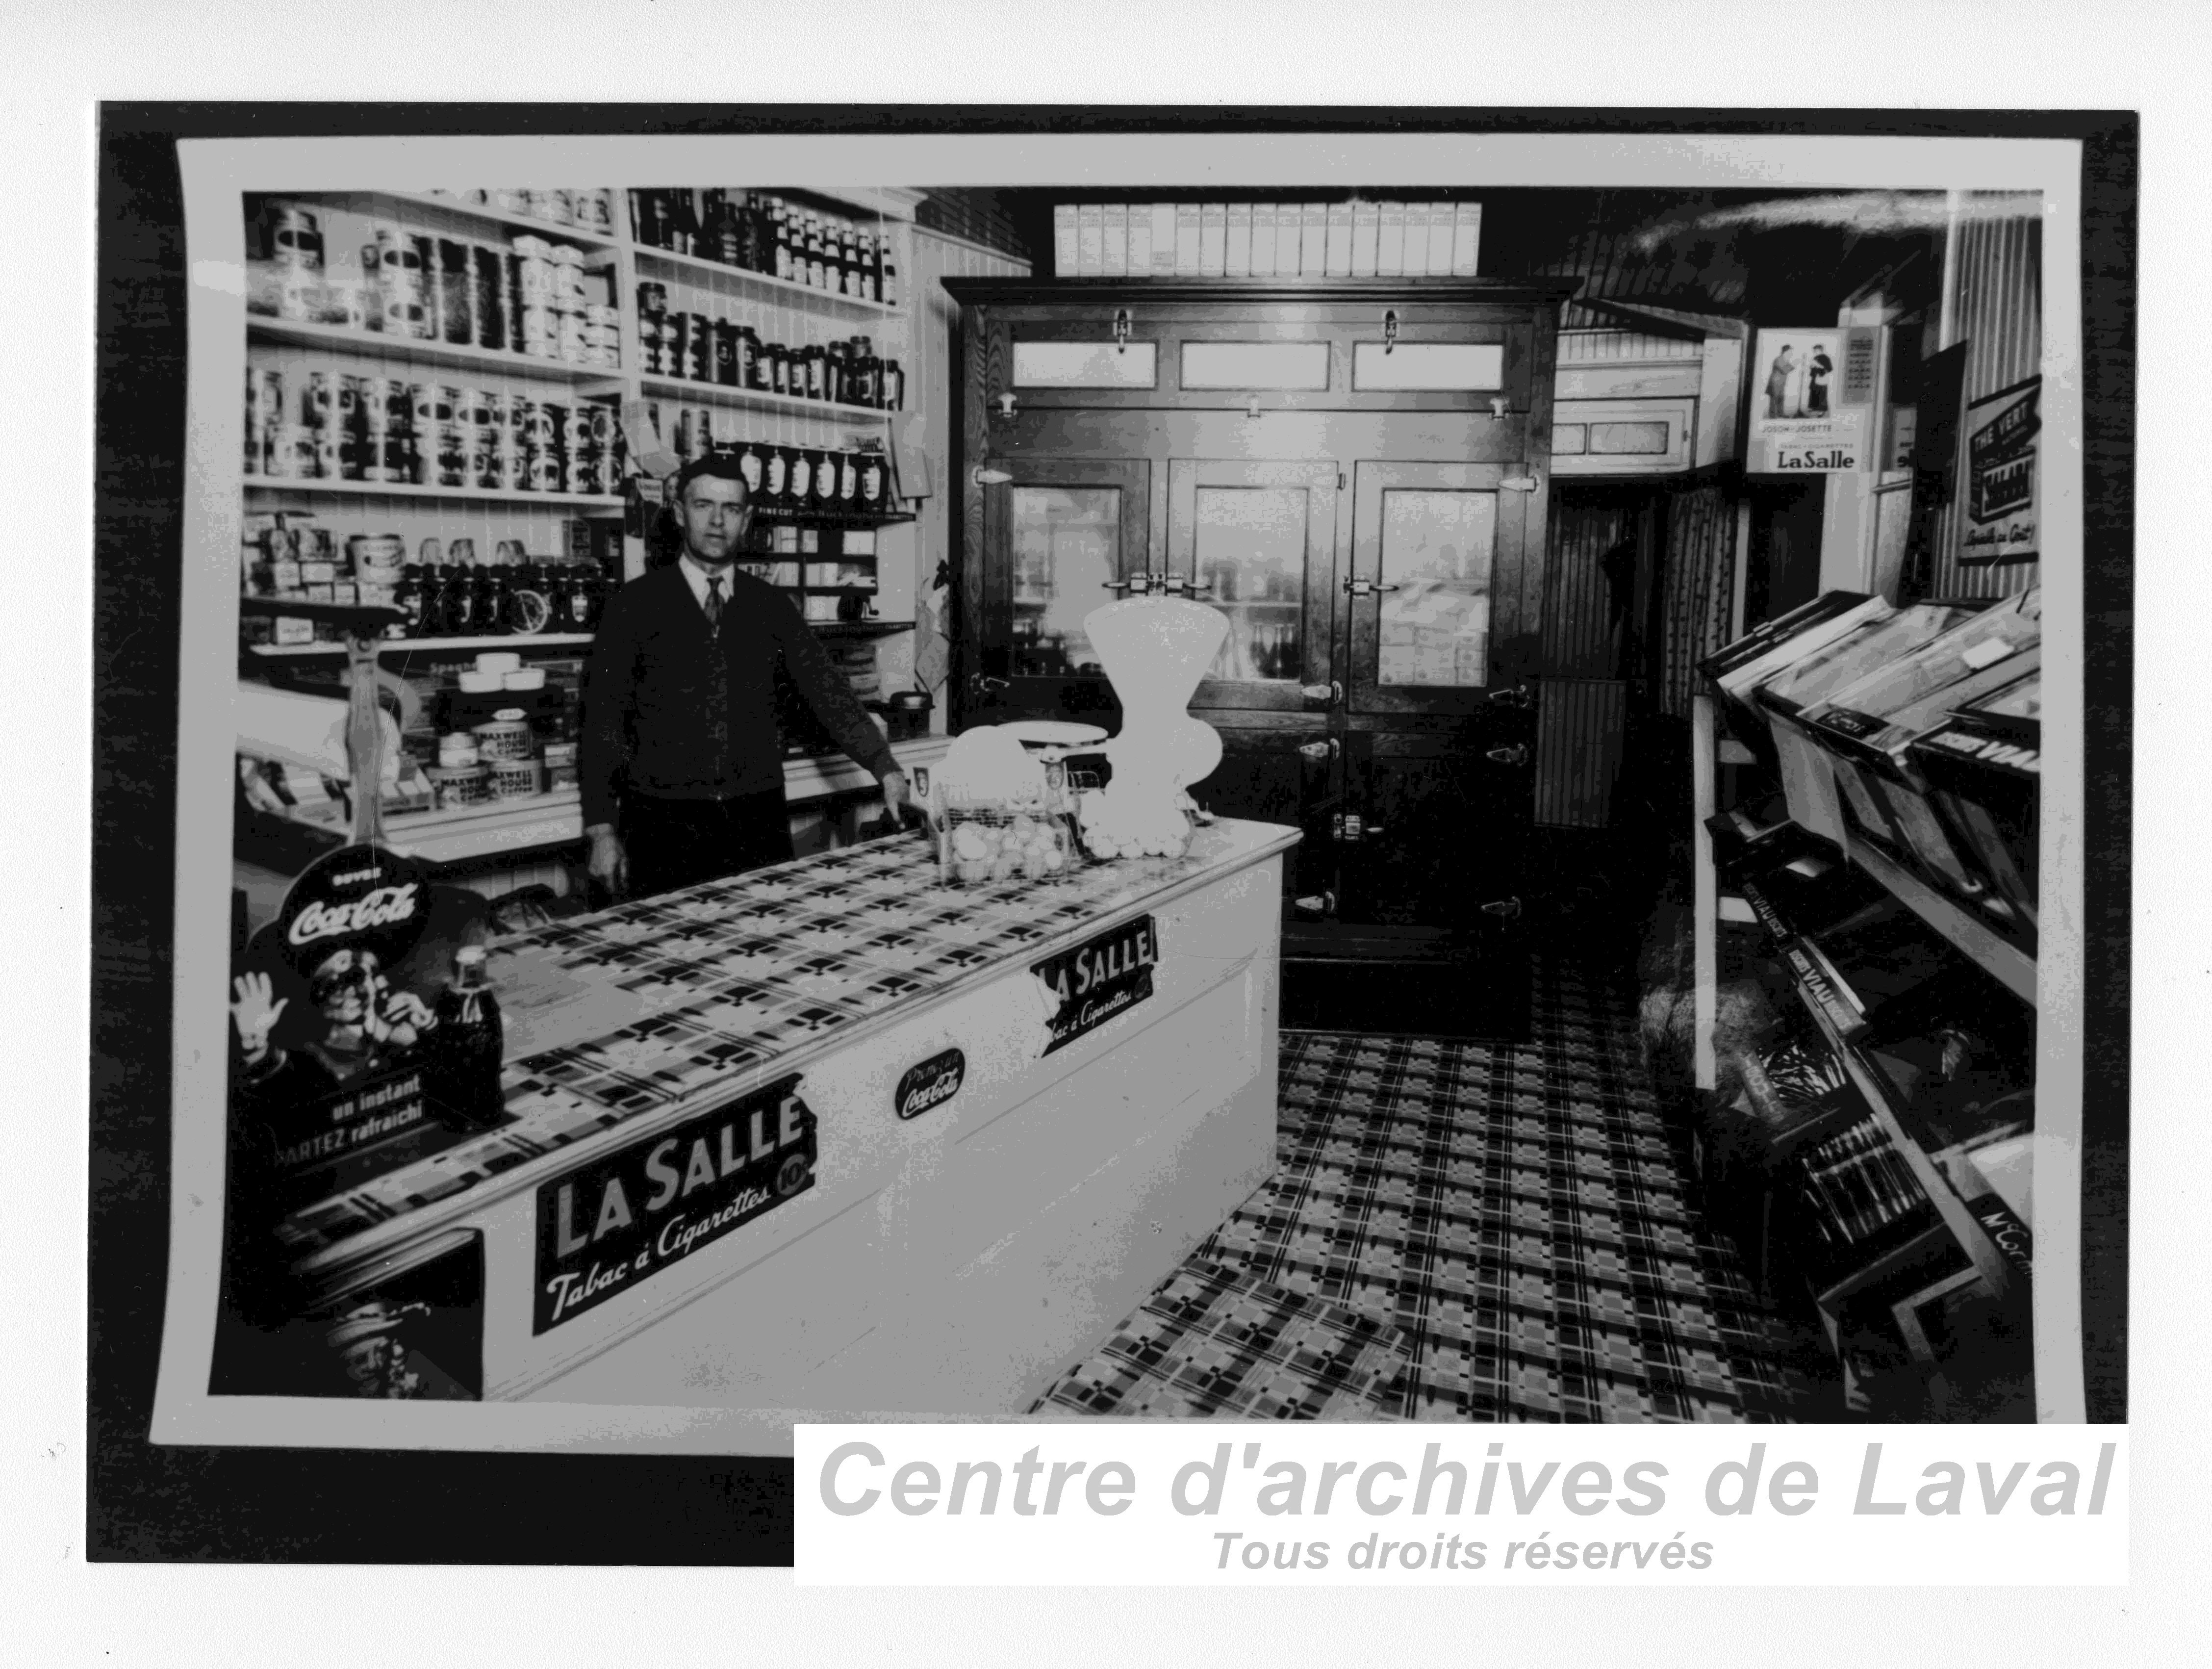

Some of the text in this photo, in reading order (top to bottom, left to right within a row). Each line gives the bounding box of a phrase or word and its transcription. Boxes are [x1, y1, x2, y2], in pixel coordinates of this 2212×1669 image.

[759, 507, 776, 515] FINE
[1754, 895, 1778, 921] VIAU
[1076, 930, 1151, 995] SALLE
[1803, 968, 1835, 1003] VIAU
[1080, 990, 1132, 1027] Cigarettes
[332, 1073, 420, 1122] un instant
[557, 1095, 804, 1259] LA SALLE
[546, 1261, 628, 1322] Tabac
[657, 1186, 771, 1255] Cigarettes
